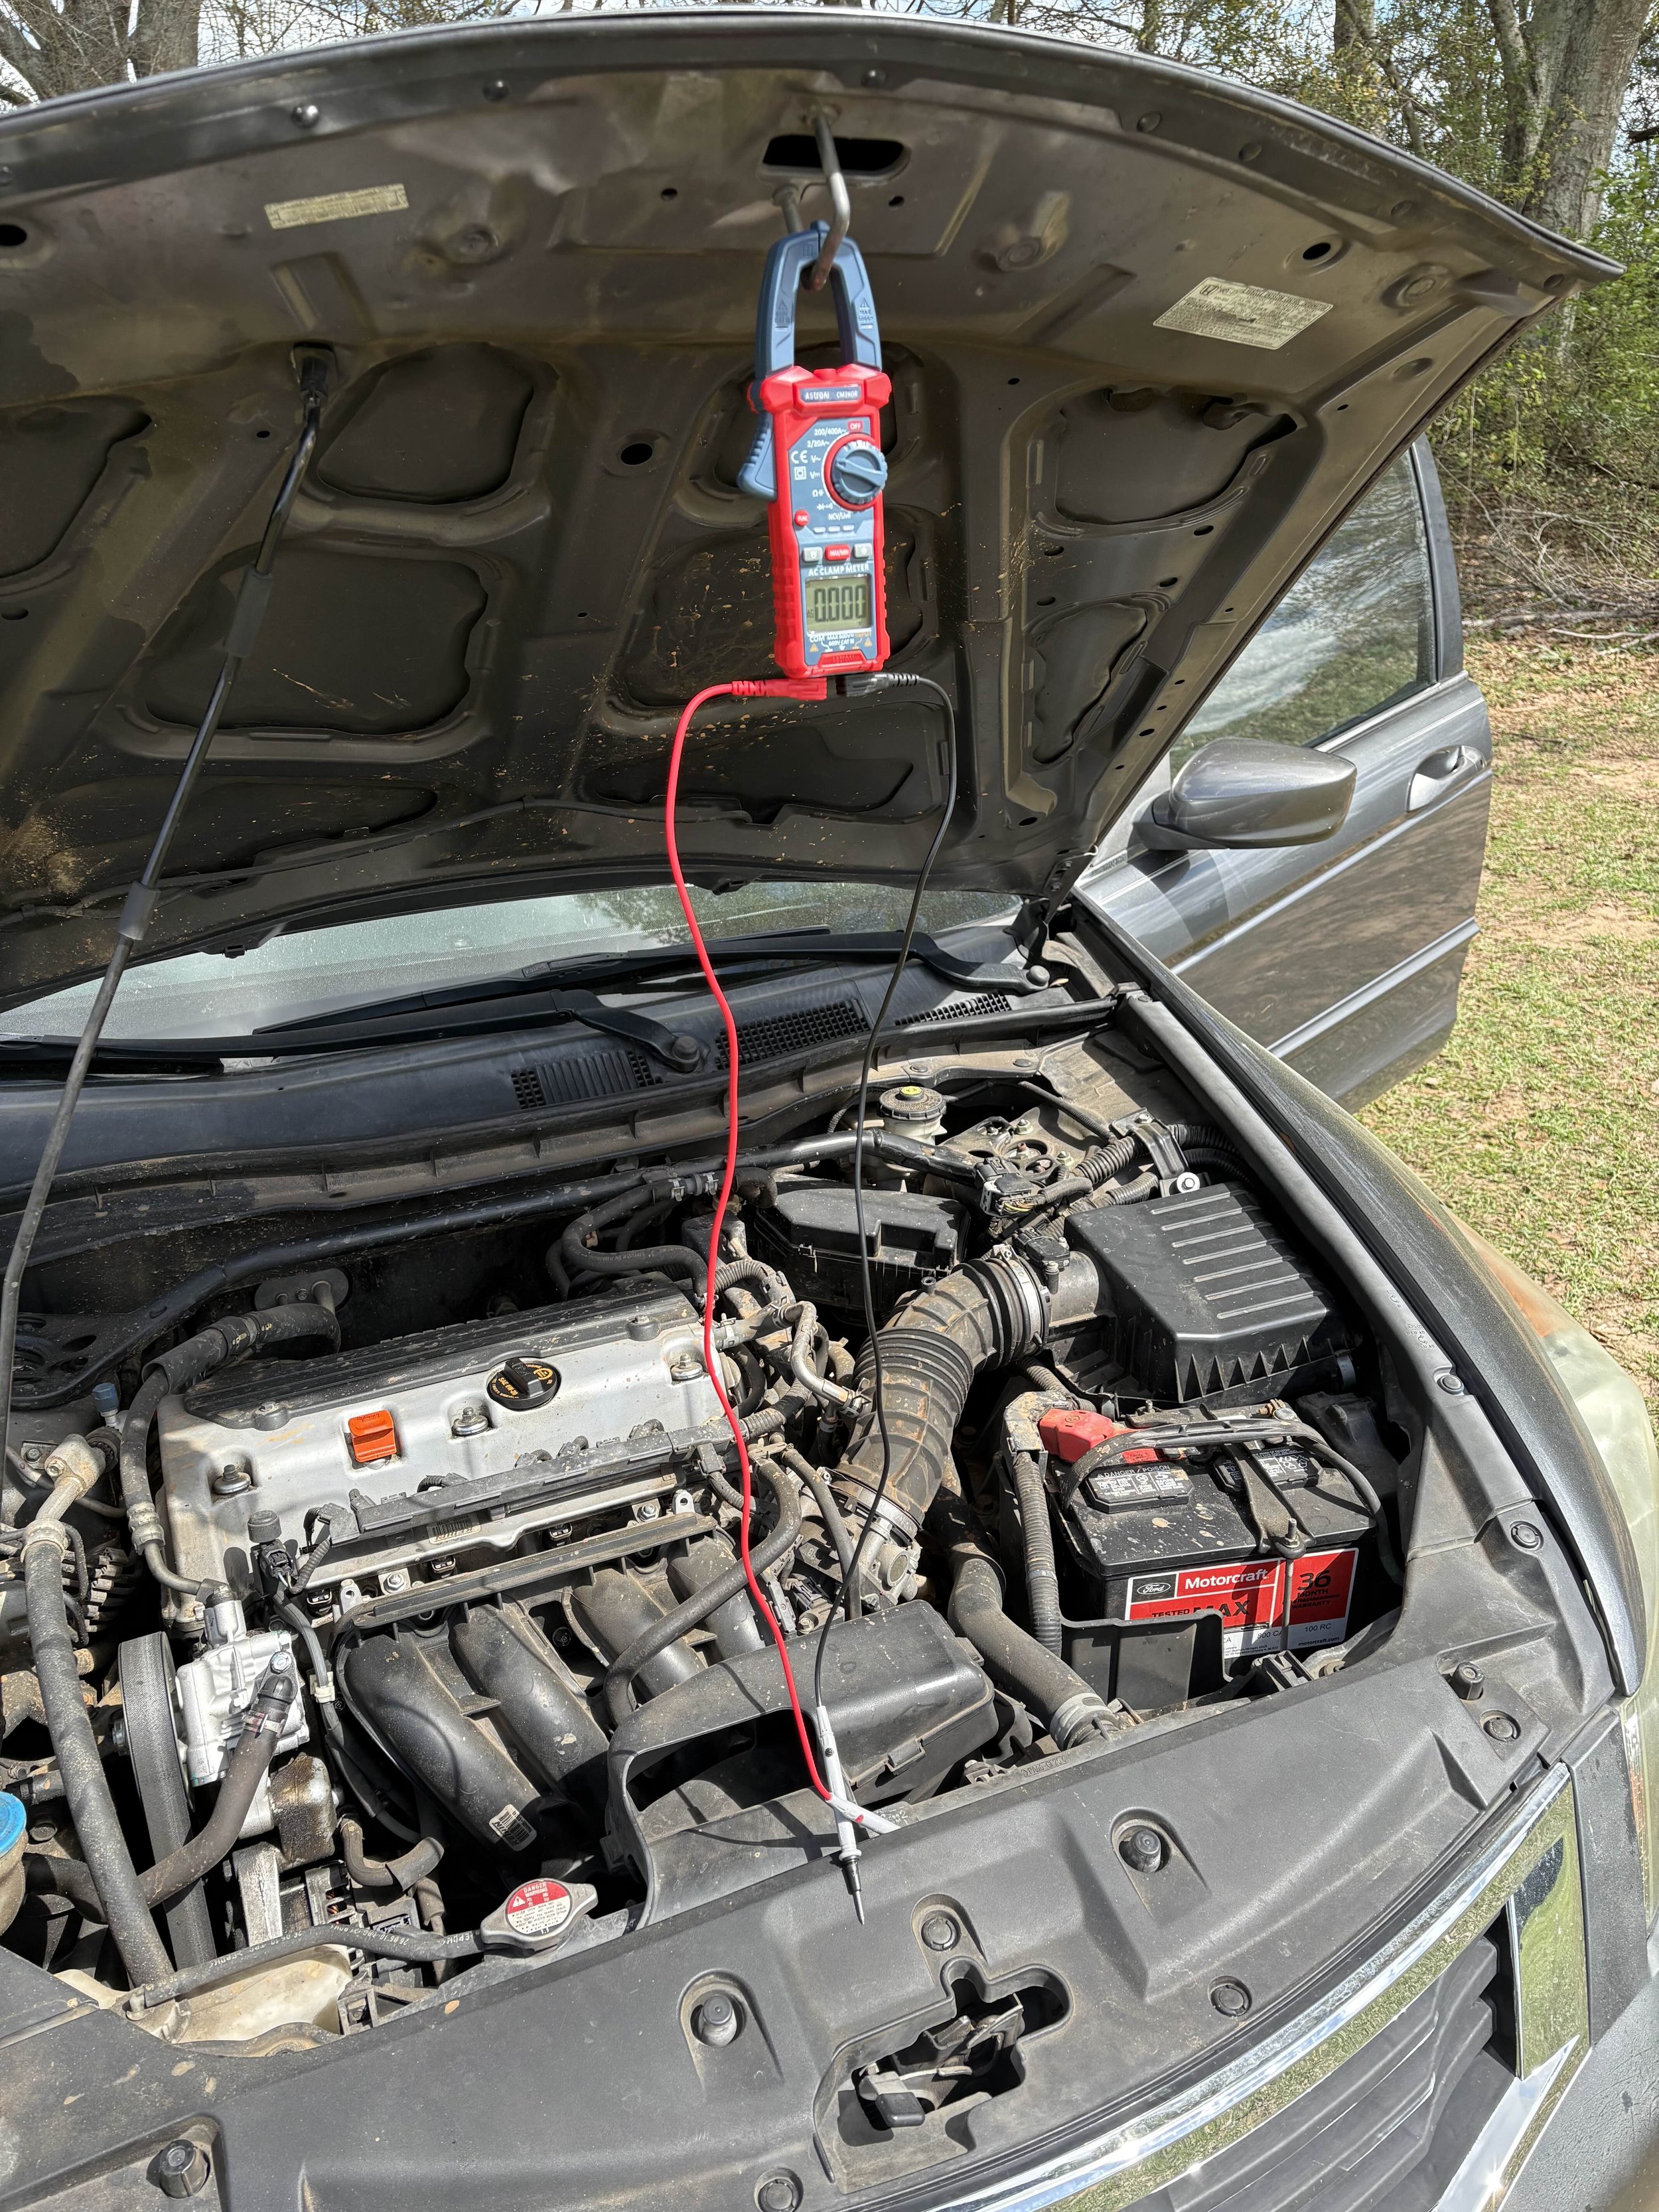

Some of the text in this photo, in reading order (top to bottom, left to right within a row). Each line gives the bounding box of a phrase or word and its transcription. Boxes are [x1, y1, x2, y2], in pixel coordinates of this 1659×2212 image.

[791, 450, 808, 464] CE
[808, 563, 869, 576] AC CLAMP METER
[814, 585, 867, 623] 0.000
[1104, 1469, 1135, 1478] DANGER
[1185, 1568, 1268, 1590] Motorcraft
[1297, 1570, 1331, 1591] 36
[1143, 1584, 1165, 1593] Ford
[1297, 1589, 1329, 1598] MONTH
[1297, 1593, 1340, 1603] Replacement
[1291, 1600, 1331, 1609] WARRANTY
[1298, 1637, 1340, 1647] motorcraft.com
